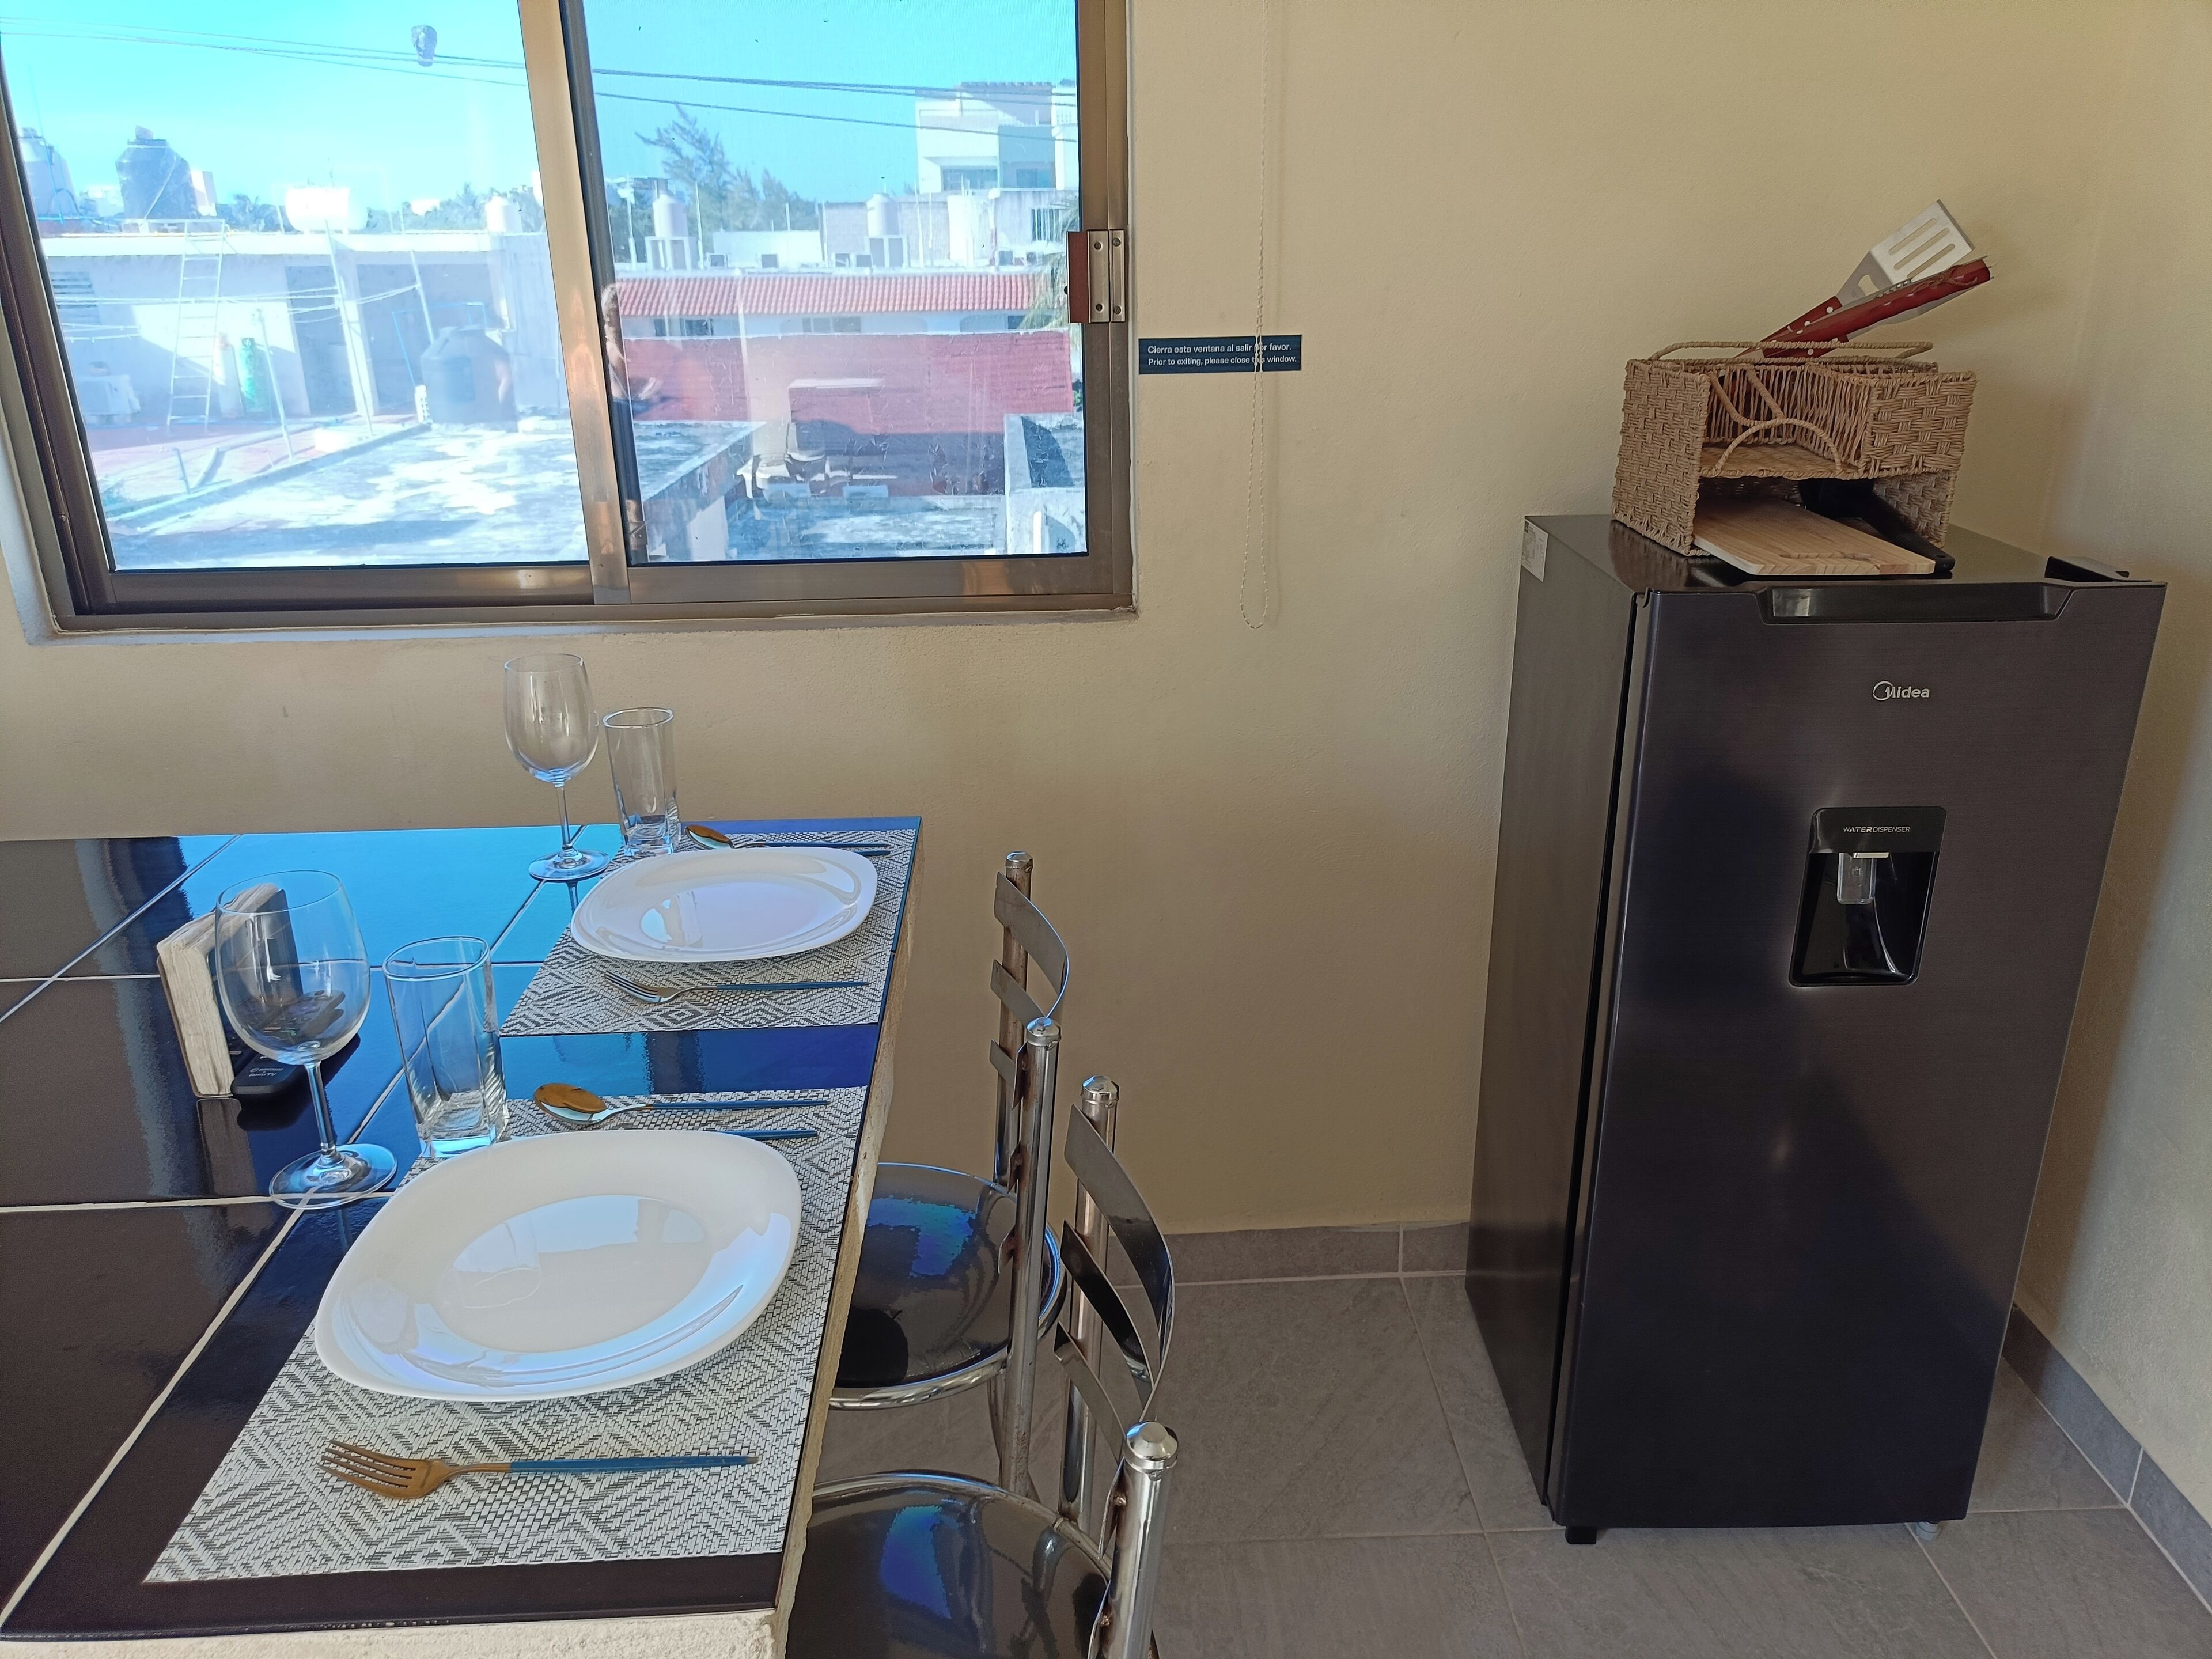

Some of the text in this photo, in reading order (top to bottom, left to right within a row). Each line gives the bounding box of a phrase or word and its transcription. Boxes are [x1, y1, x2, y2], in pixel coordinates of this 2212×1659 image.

[1147, 346, 1172, 354] Cierra
[1174, 345, 1192, 353] esta
[1193, 344, 1225, 353] ventana
[1226, 344, 1234, 352] al
[1236, 343, 1252, 351] salir
[1269, 343, 1291, 351] favor.
[1177, 357, 1203, 366] exiting,
[1205, 357, 1229, 366] please
[1267, 355, 1297, 363] window.
[1873, 680, 1930, 701] Midea
